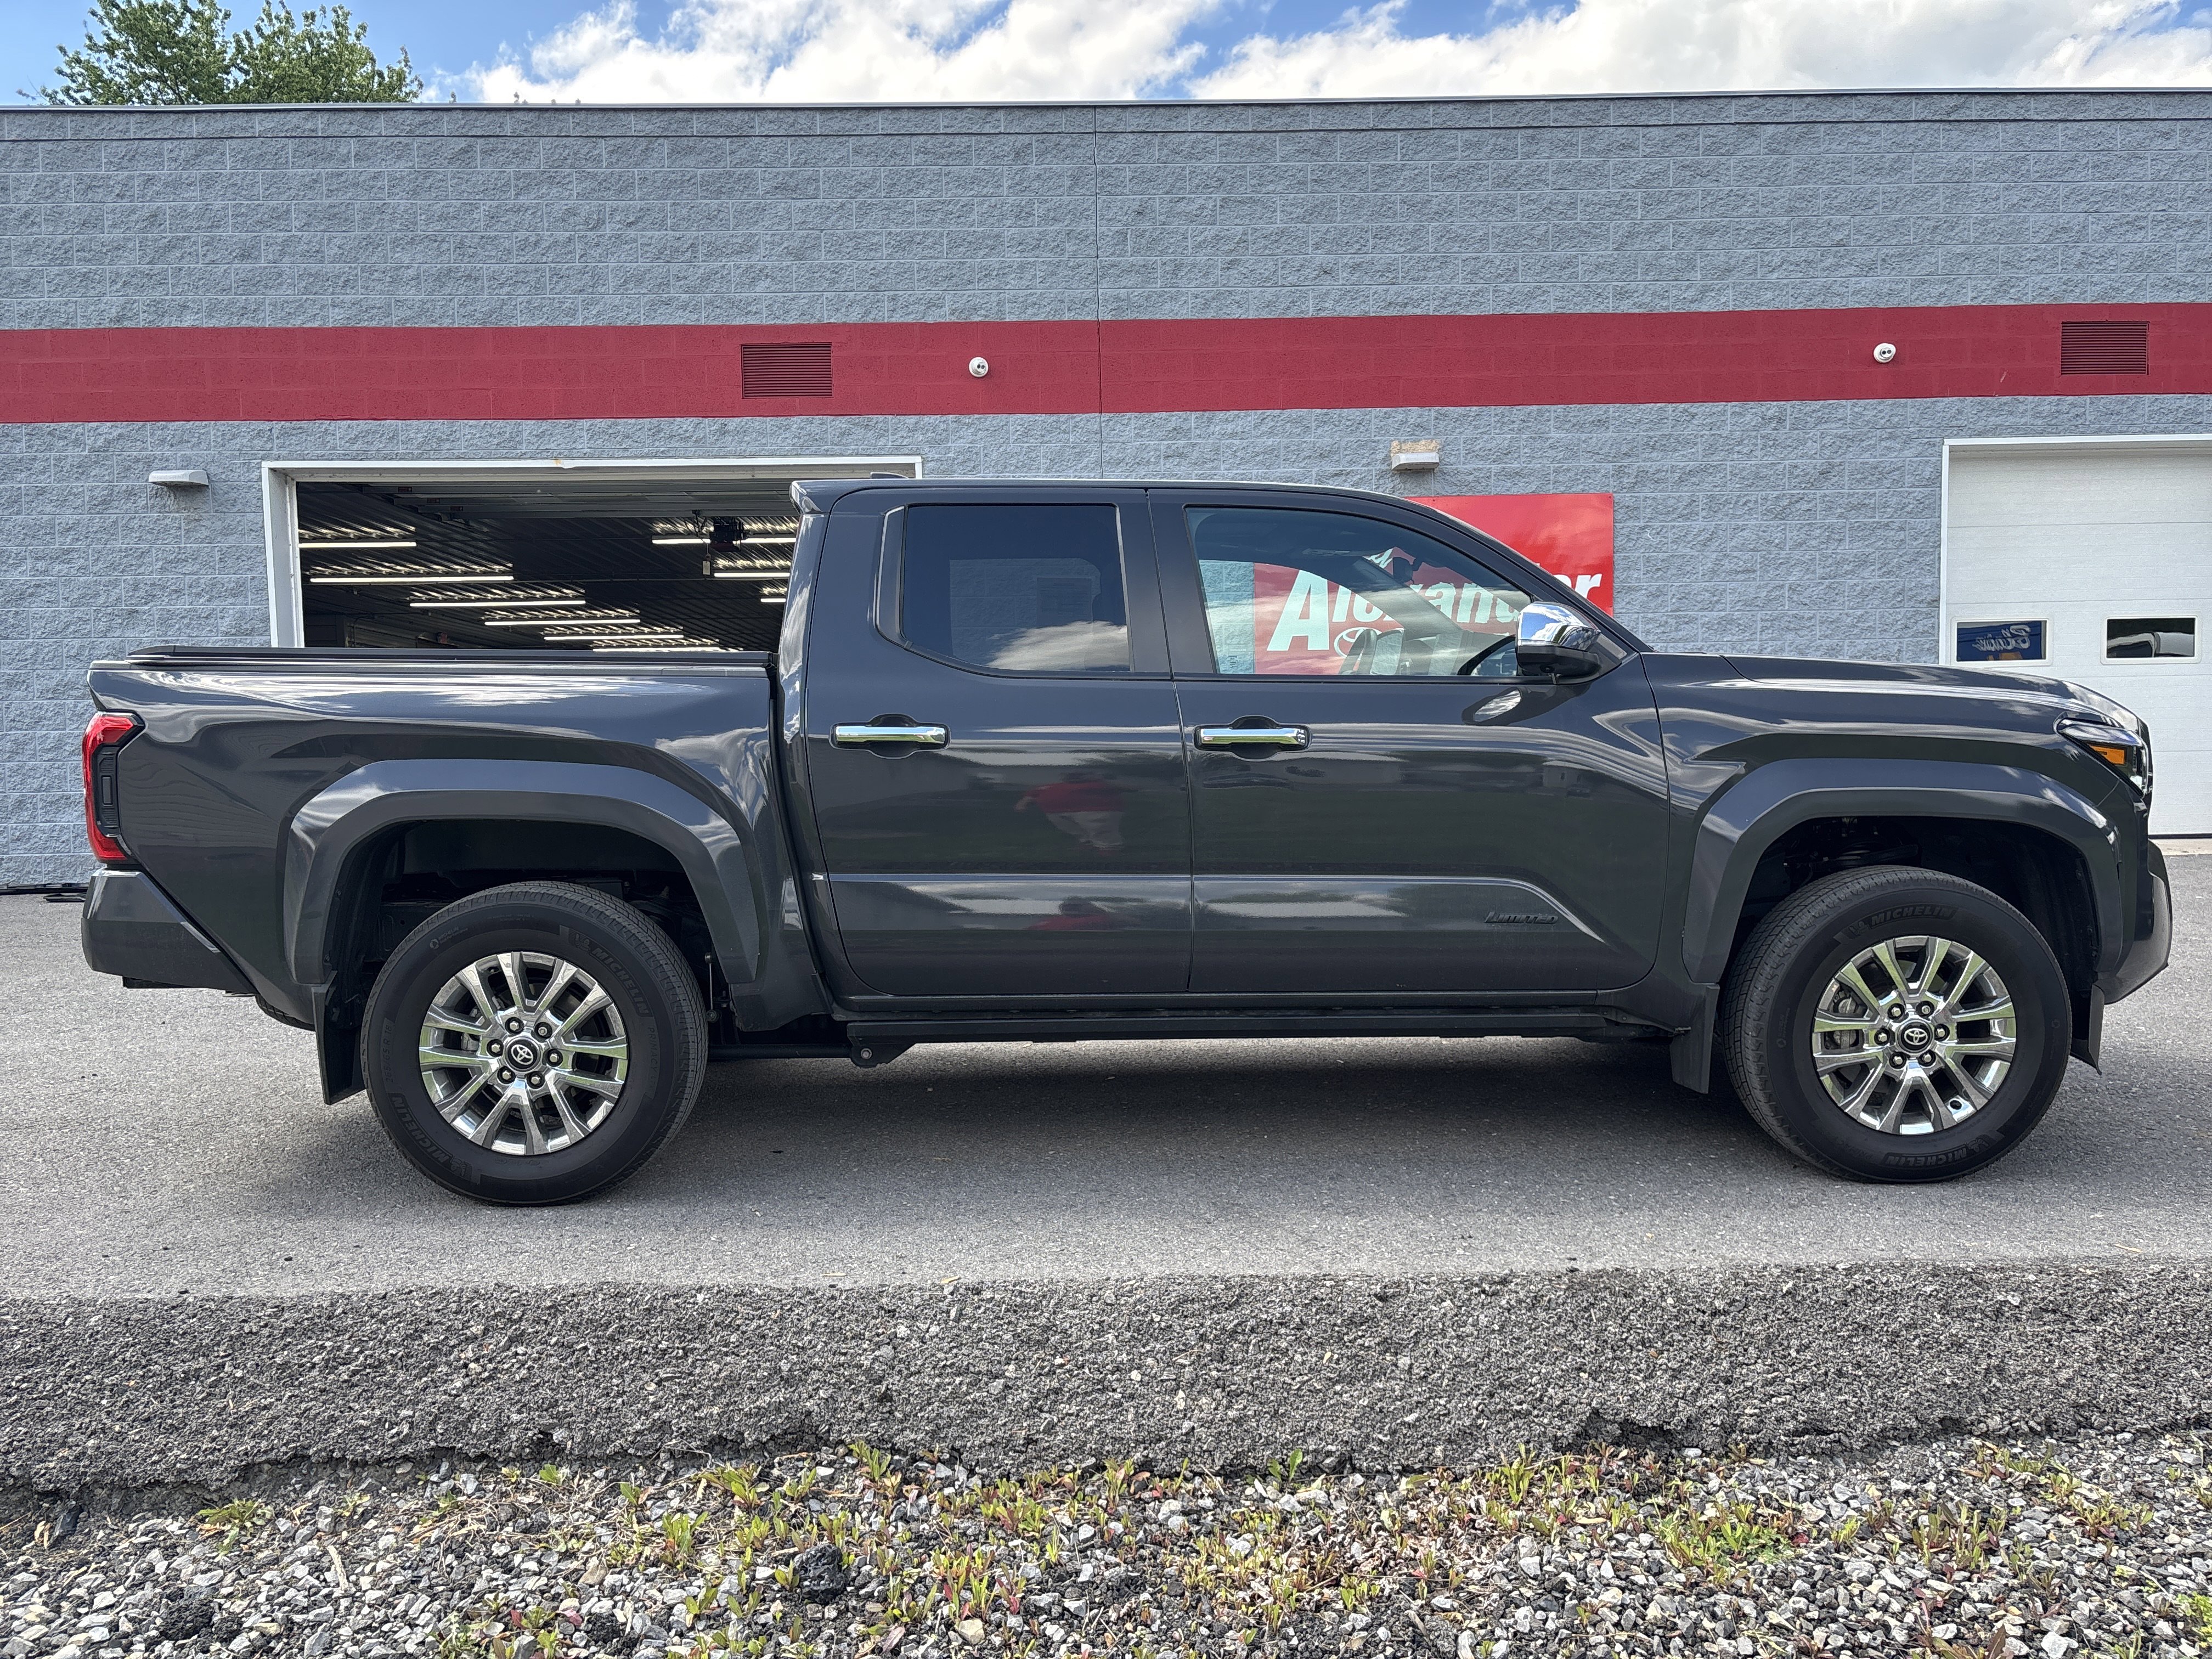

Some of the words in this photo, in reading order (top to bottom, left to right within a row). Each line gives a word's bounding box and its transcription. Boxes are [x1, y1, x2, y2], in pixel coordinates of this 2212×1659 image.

[1484, 911, 1559, 924] LIMITED
[1871, 905, 1953, 926] MICHELIN
[591, 947, 650, 1014] MICHELIN
[385, 1025, 392, 1035] 18
[646, 1026, 658, 1075] PRIMACY
[392, 1096, 452, 1164] MICHELIN
[1886, 1147, 1968, 1167] MICHELIN
